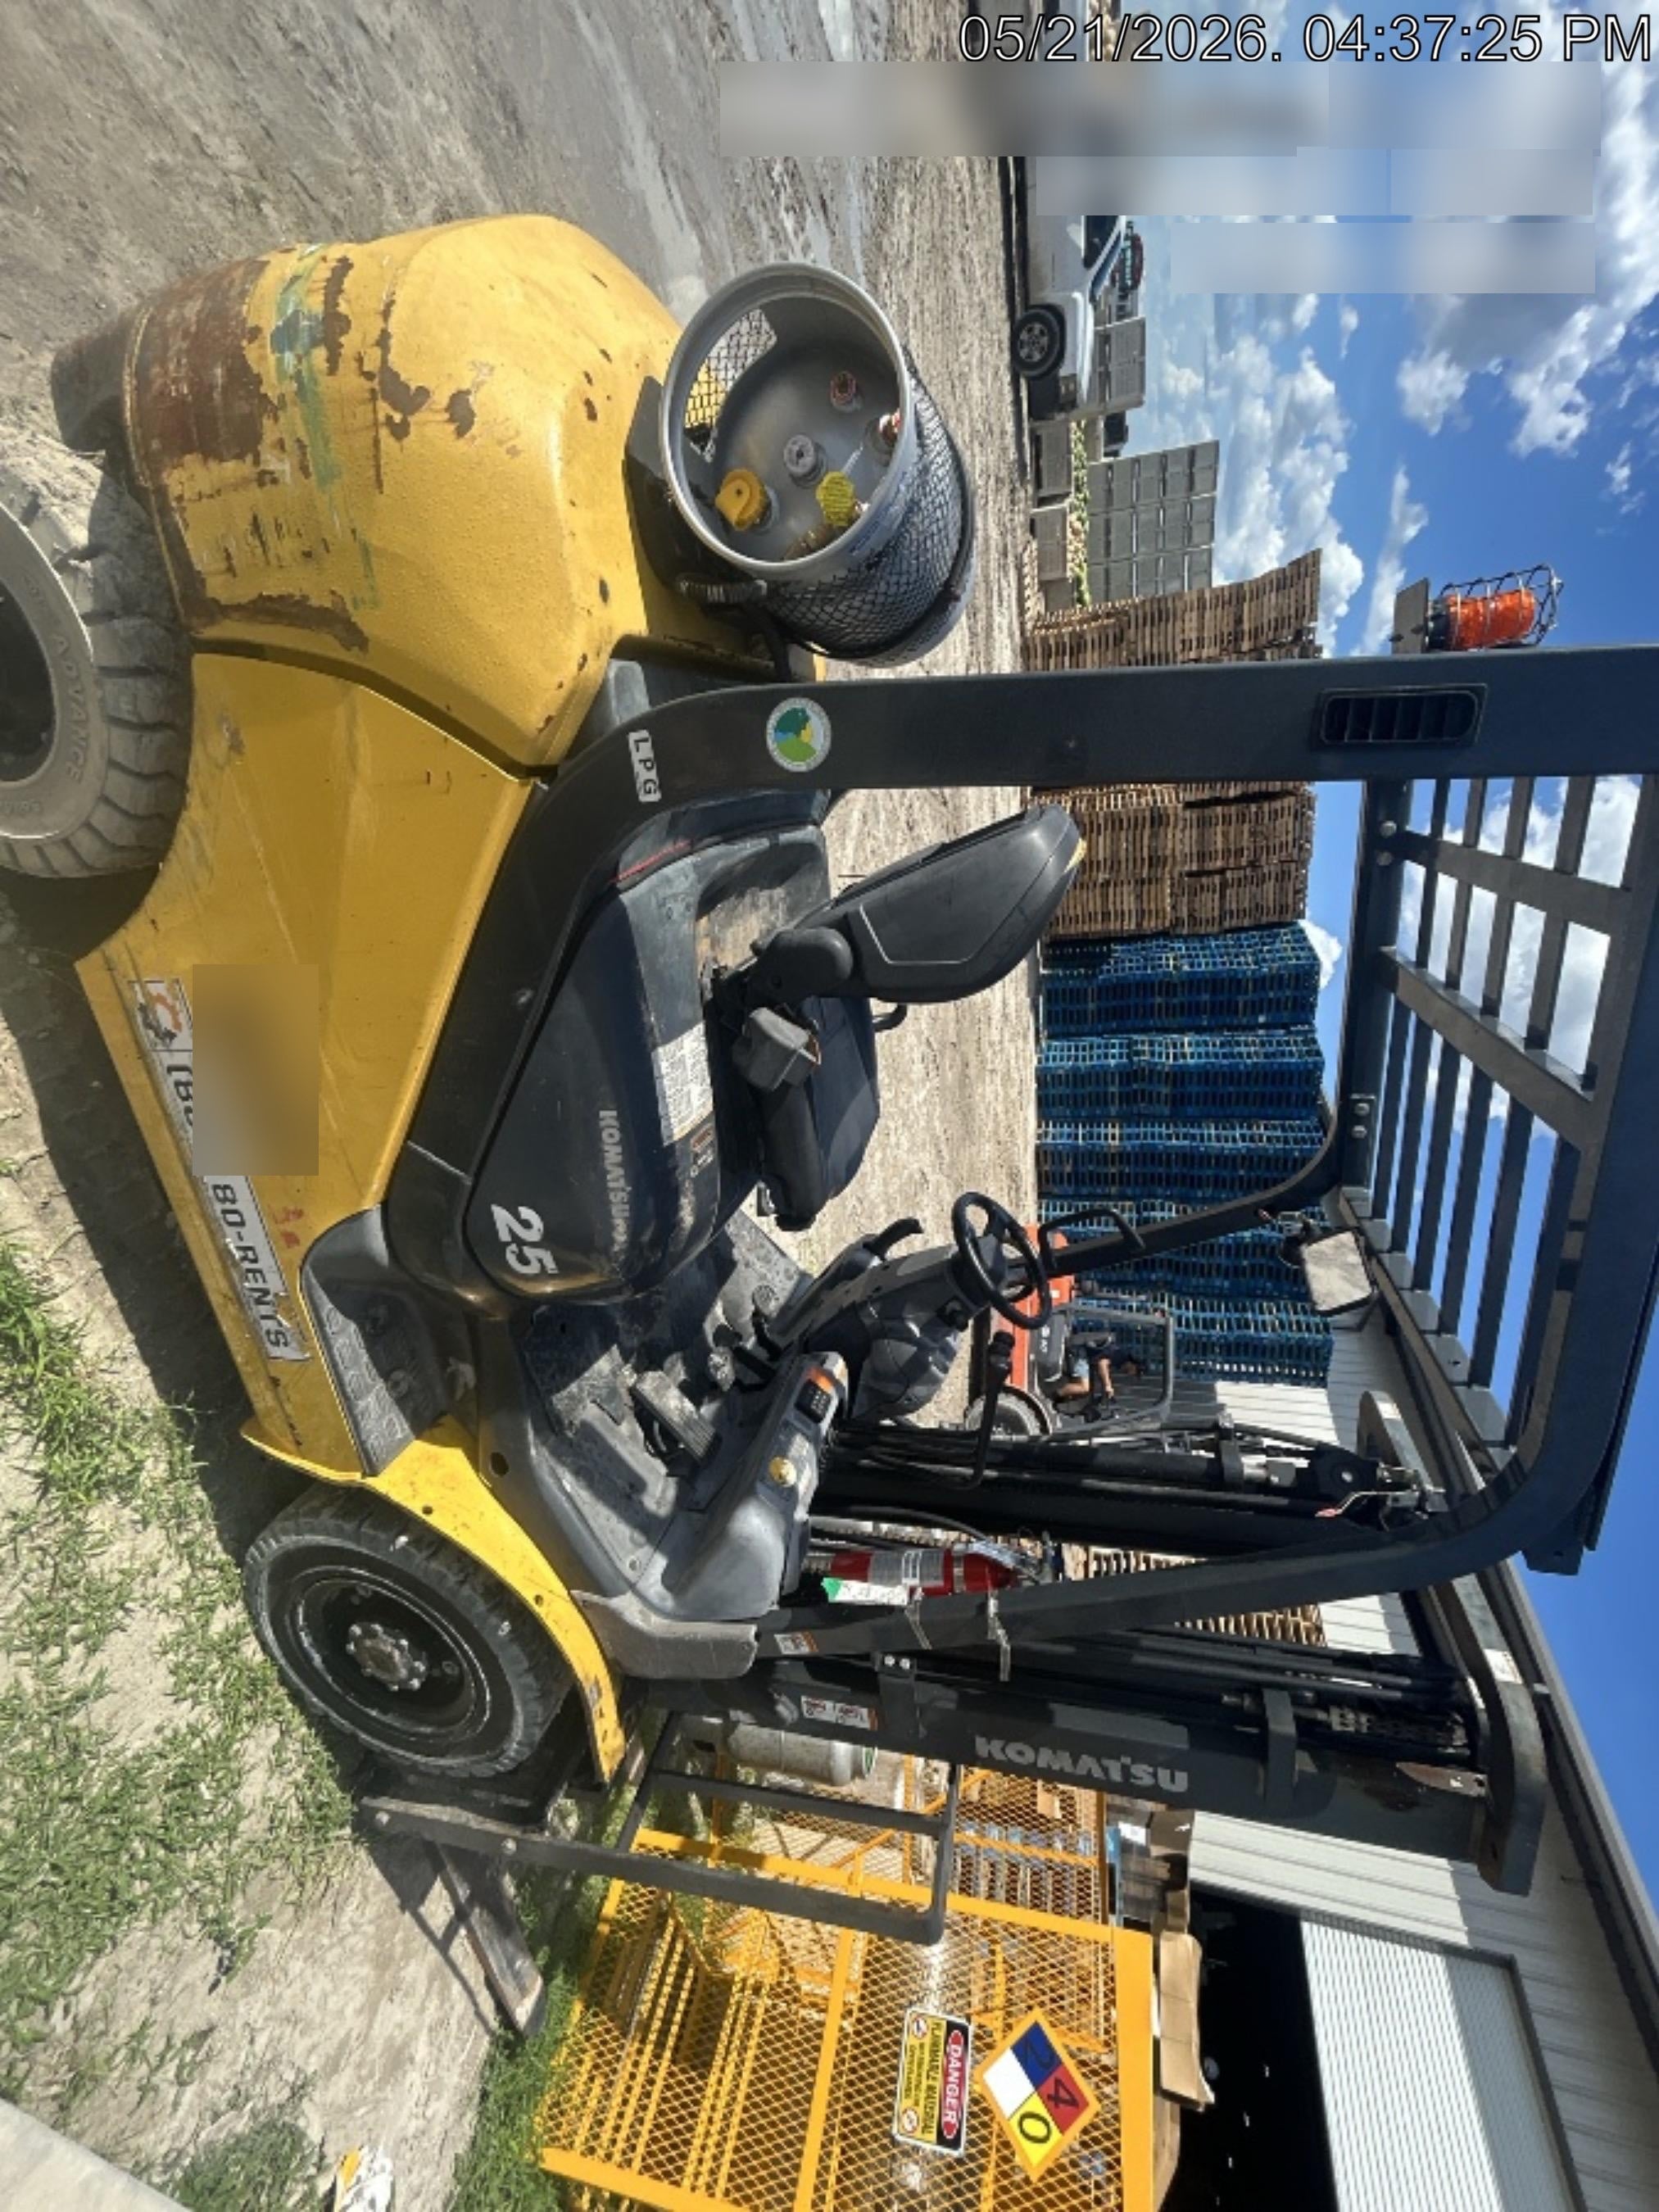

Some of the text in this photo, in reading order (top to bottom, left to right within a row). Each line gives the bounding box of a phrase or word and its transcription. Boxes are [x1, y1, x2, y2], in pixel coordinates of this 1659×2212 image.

[51, 636, 88, 782] ADVANCE
[599, 1110, 631, 1217] KOMATSU
[490, 1204, 558, 1274] 25
[975, 1736, 1189, 1793] KOMATSU
[942, 2044, 962, 2124] DANGER
[1024, 2034, 1055, 2071] 2
[1046, 2078, 1080, 2110] 4
[1018, 2111, 1053, 2145] 0
